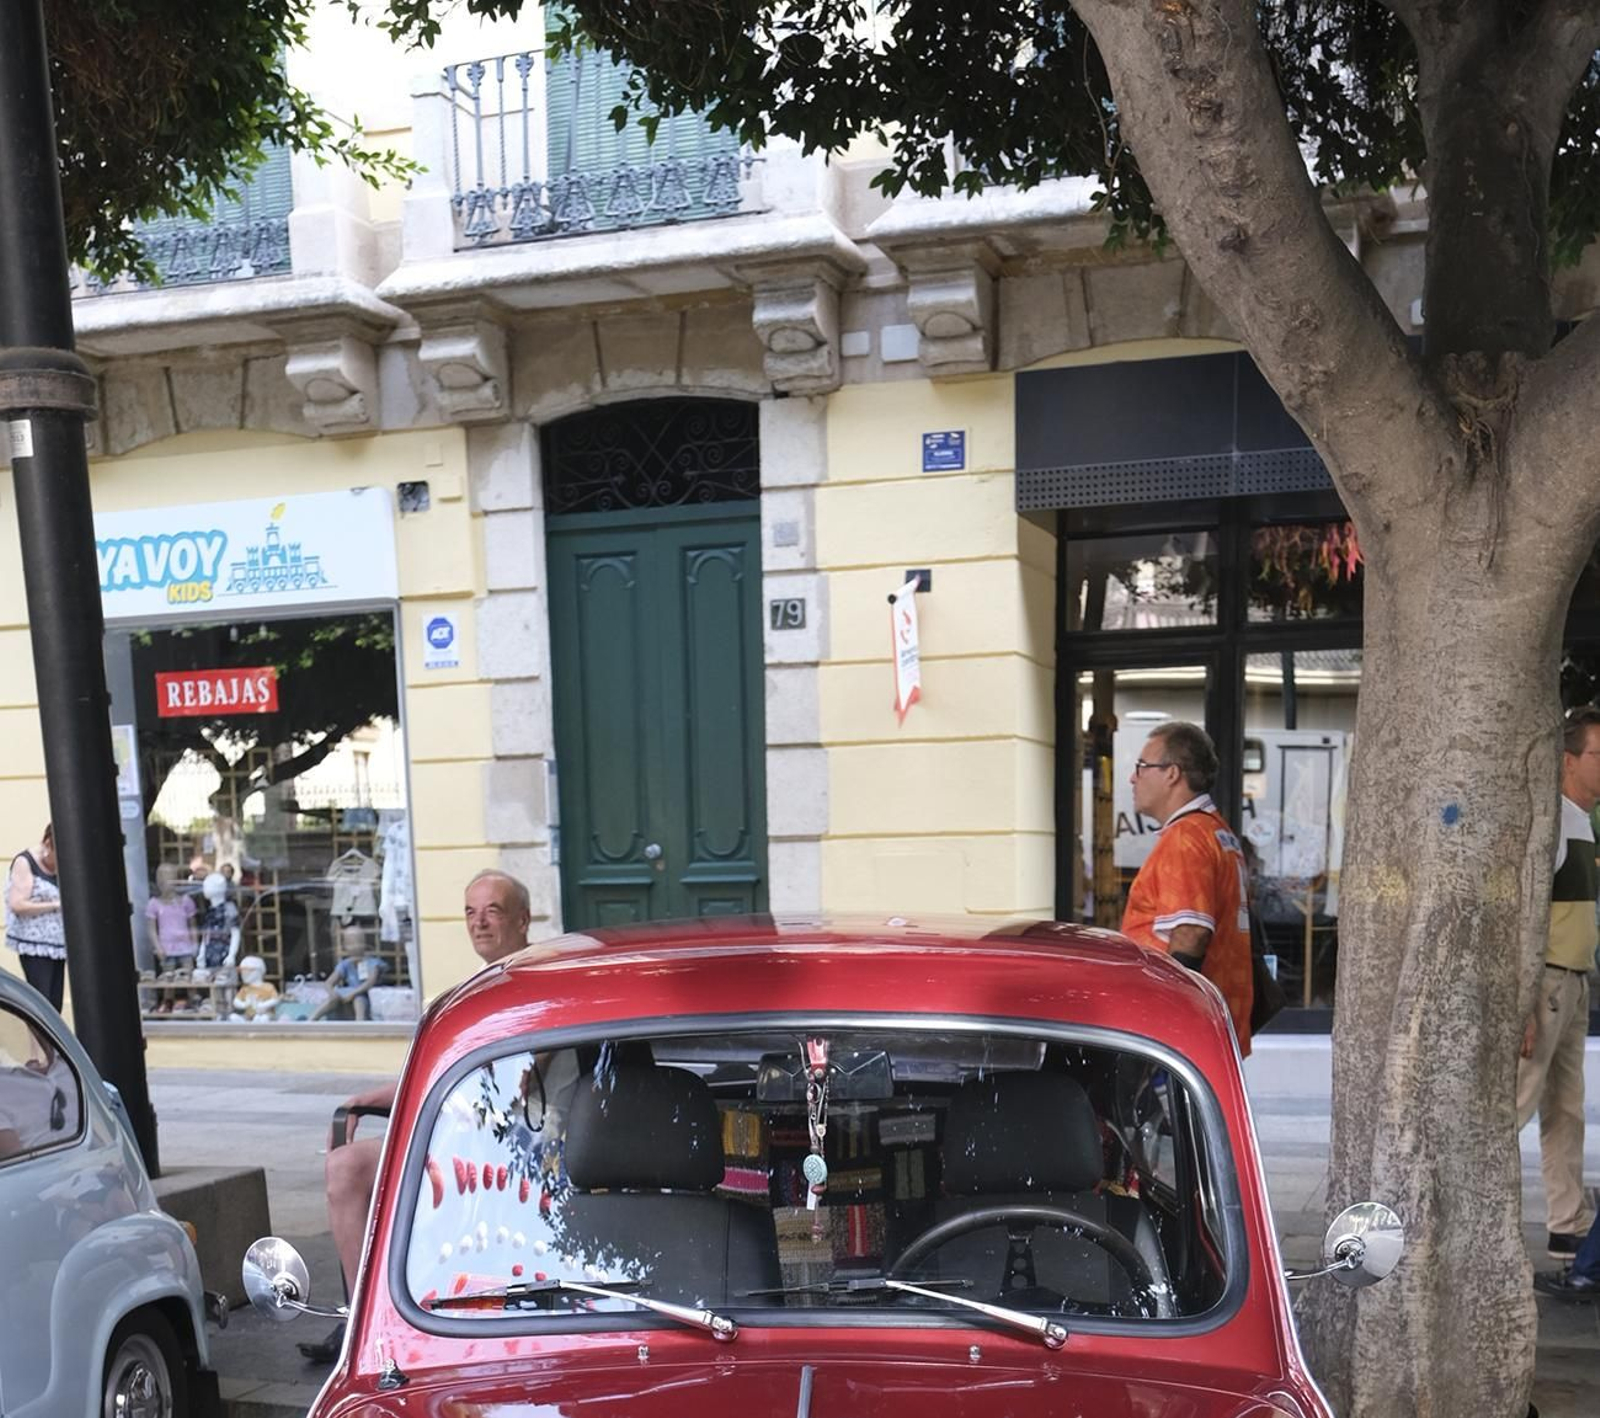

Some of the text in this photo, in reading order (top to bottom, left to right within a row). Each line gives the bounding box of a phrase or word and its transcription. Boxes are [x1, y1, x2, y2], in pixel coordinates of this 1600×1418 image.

[168, 581, 213, 604] KIDS
[772, 600, 803, 627] 79
[166, 677, 271, 708] REBAJAS
